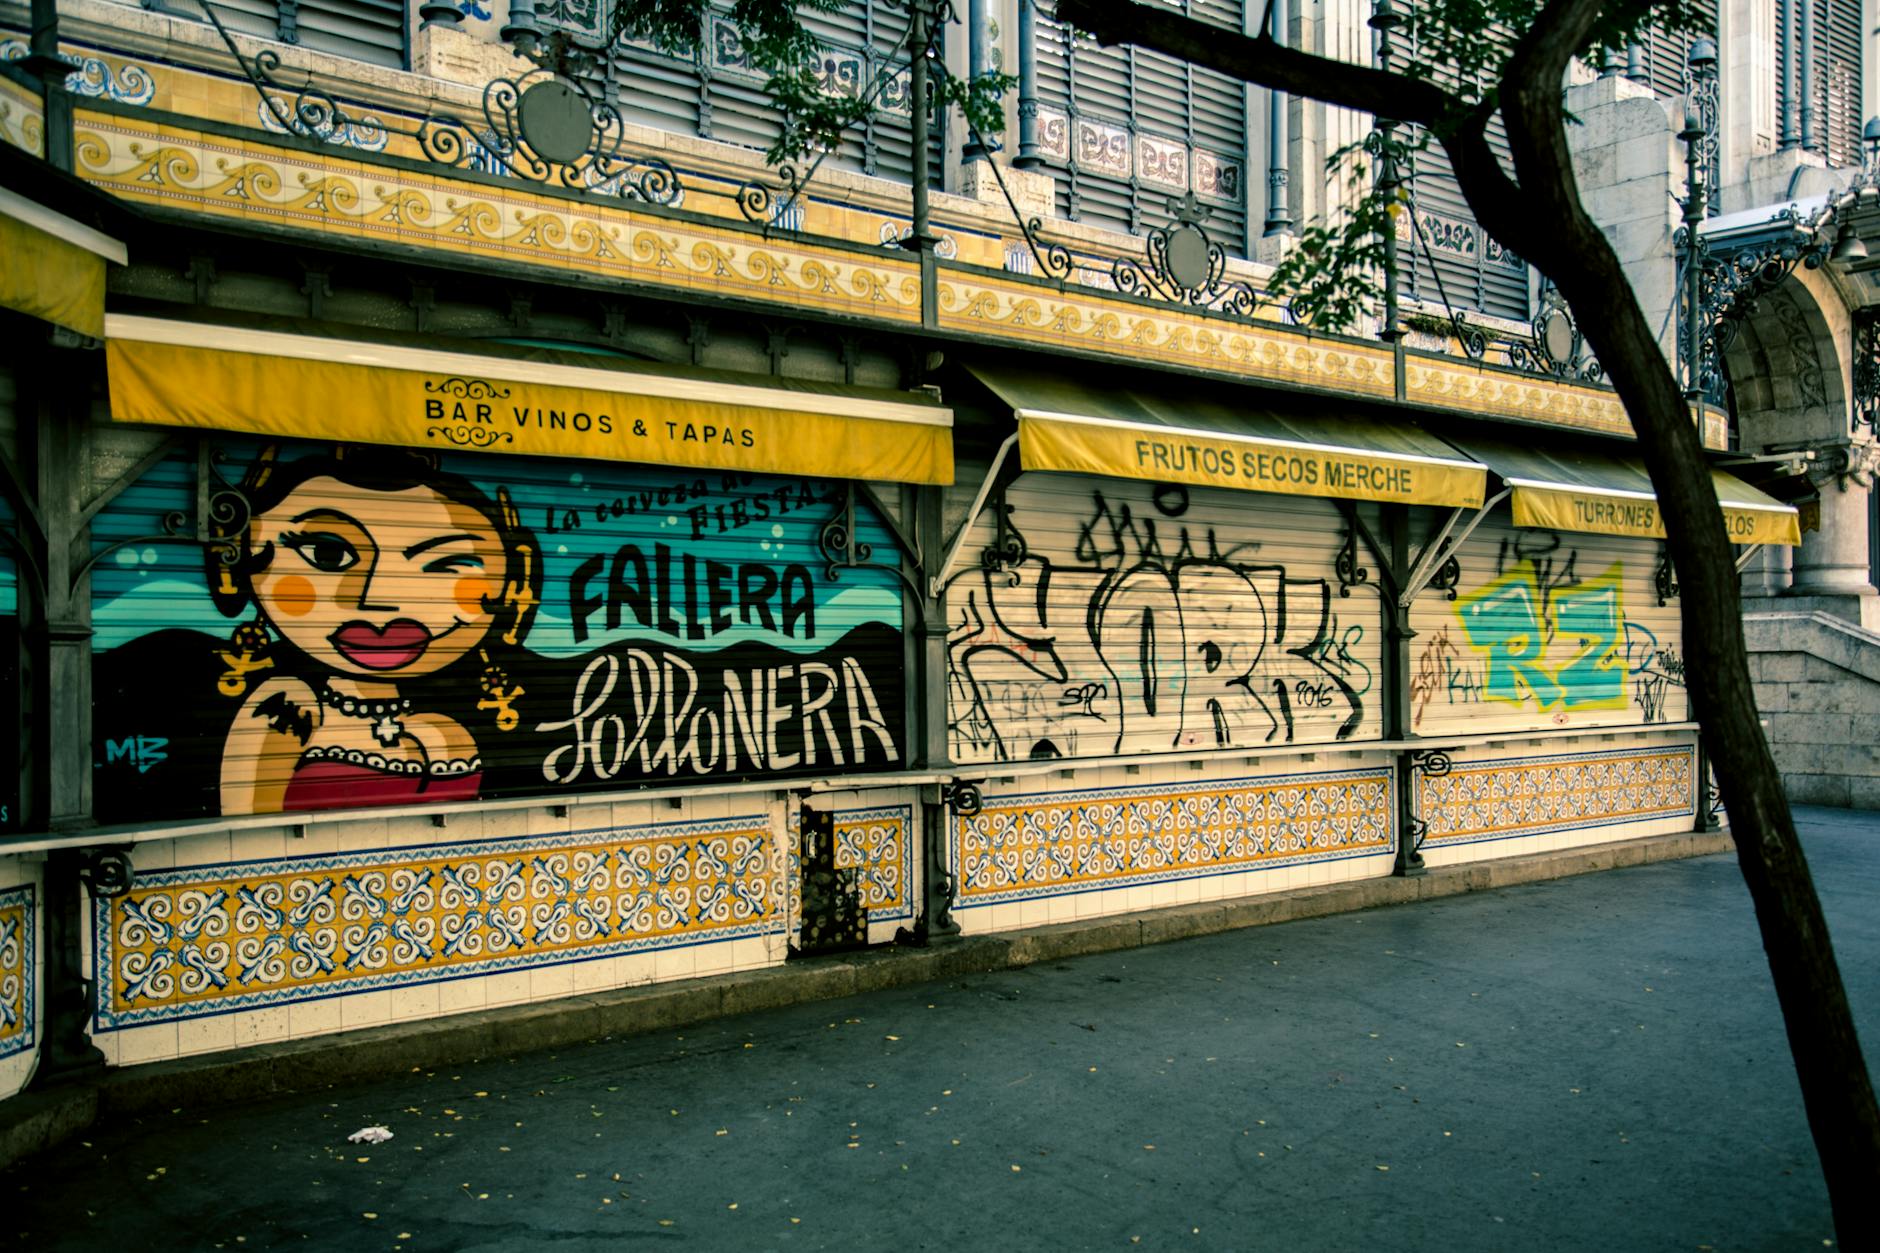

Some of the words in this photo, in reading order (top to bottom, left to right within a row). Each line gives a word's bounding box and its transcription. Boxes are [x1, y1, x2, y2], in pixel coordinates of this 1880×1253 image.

[425, 399, 493, 424] BAR
[513, 407, 613, 434] VINOS
[632, 418, 648, 437] &
[665, 421, 755, 448] TAPAS
[1135, 440, 1236, 476] FRUTOS
[1242, 451, 1319, 485] SECOS
[1324, 461, 1412, 493] MERCHE
[1575, 500, 1654, 528] TURRONES
[569, 541, 816, 645] FALLERA
